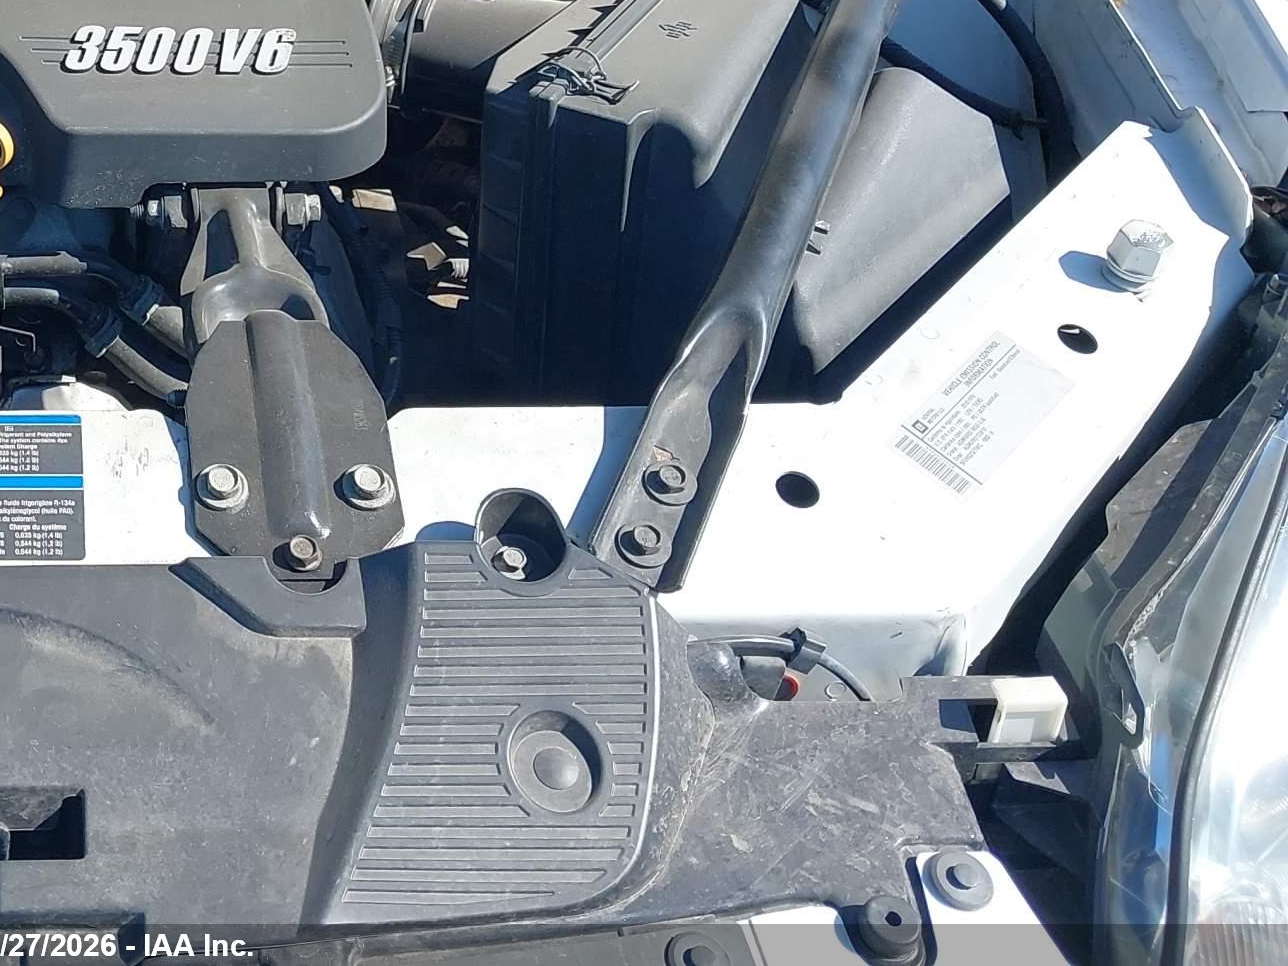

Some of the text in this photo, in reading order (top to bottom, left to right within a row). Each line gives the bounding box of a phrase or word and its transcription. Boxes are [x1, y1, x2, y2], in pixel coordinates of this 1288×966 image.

[61, 24, 297, 75] 3500 V6
[963, 358, 994, 387] INFORMATION
